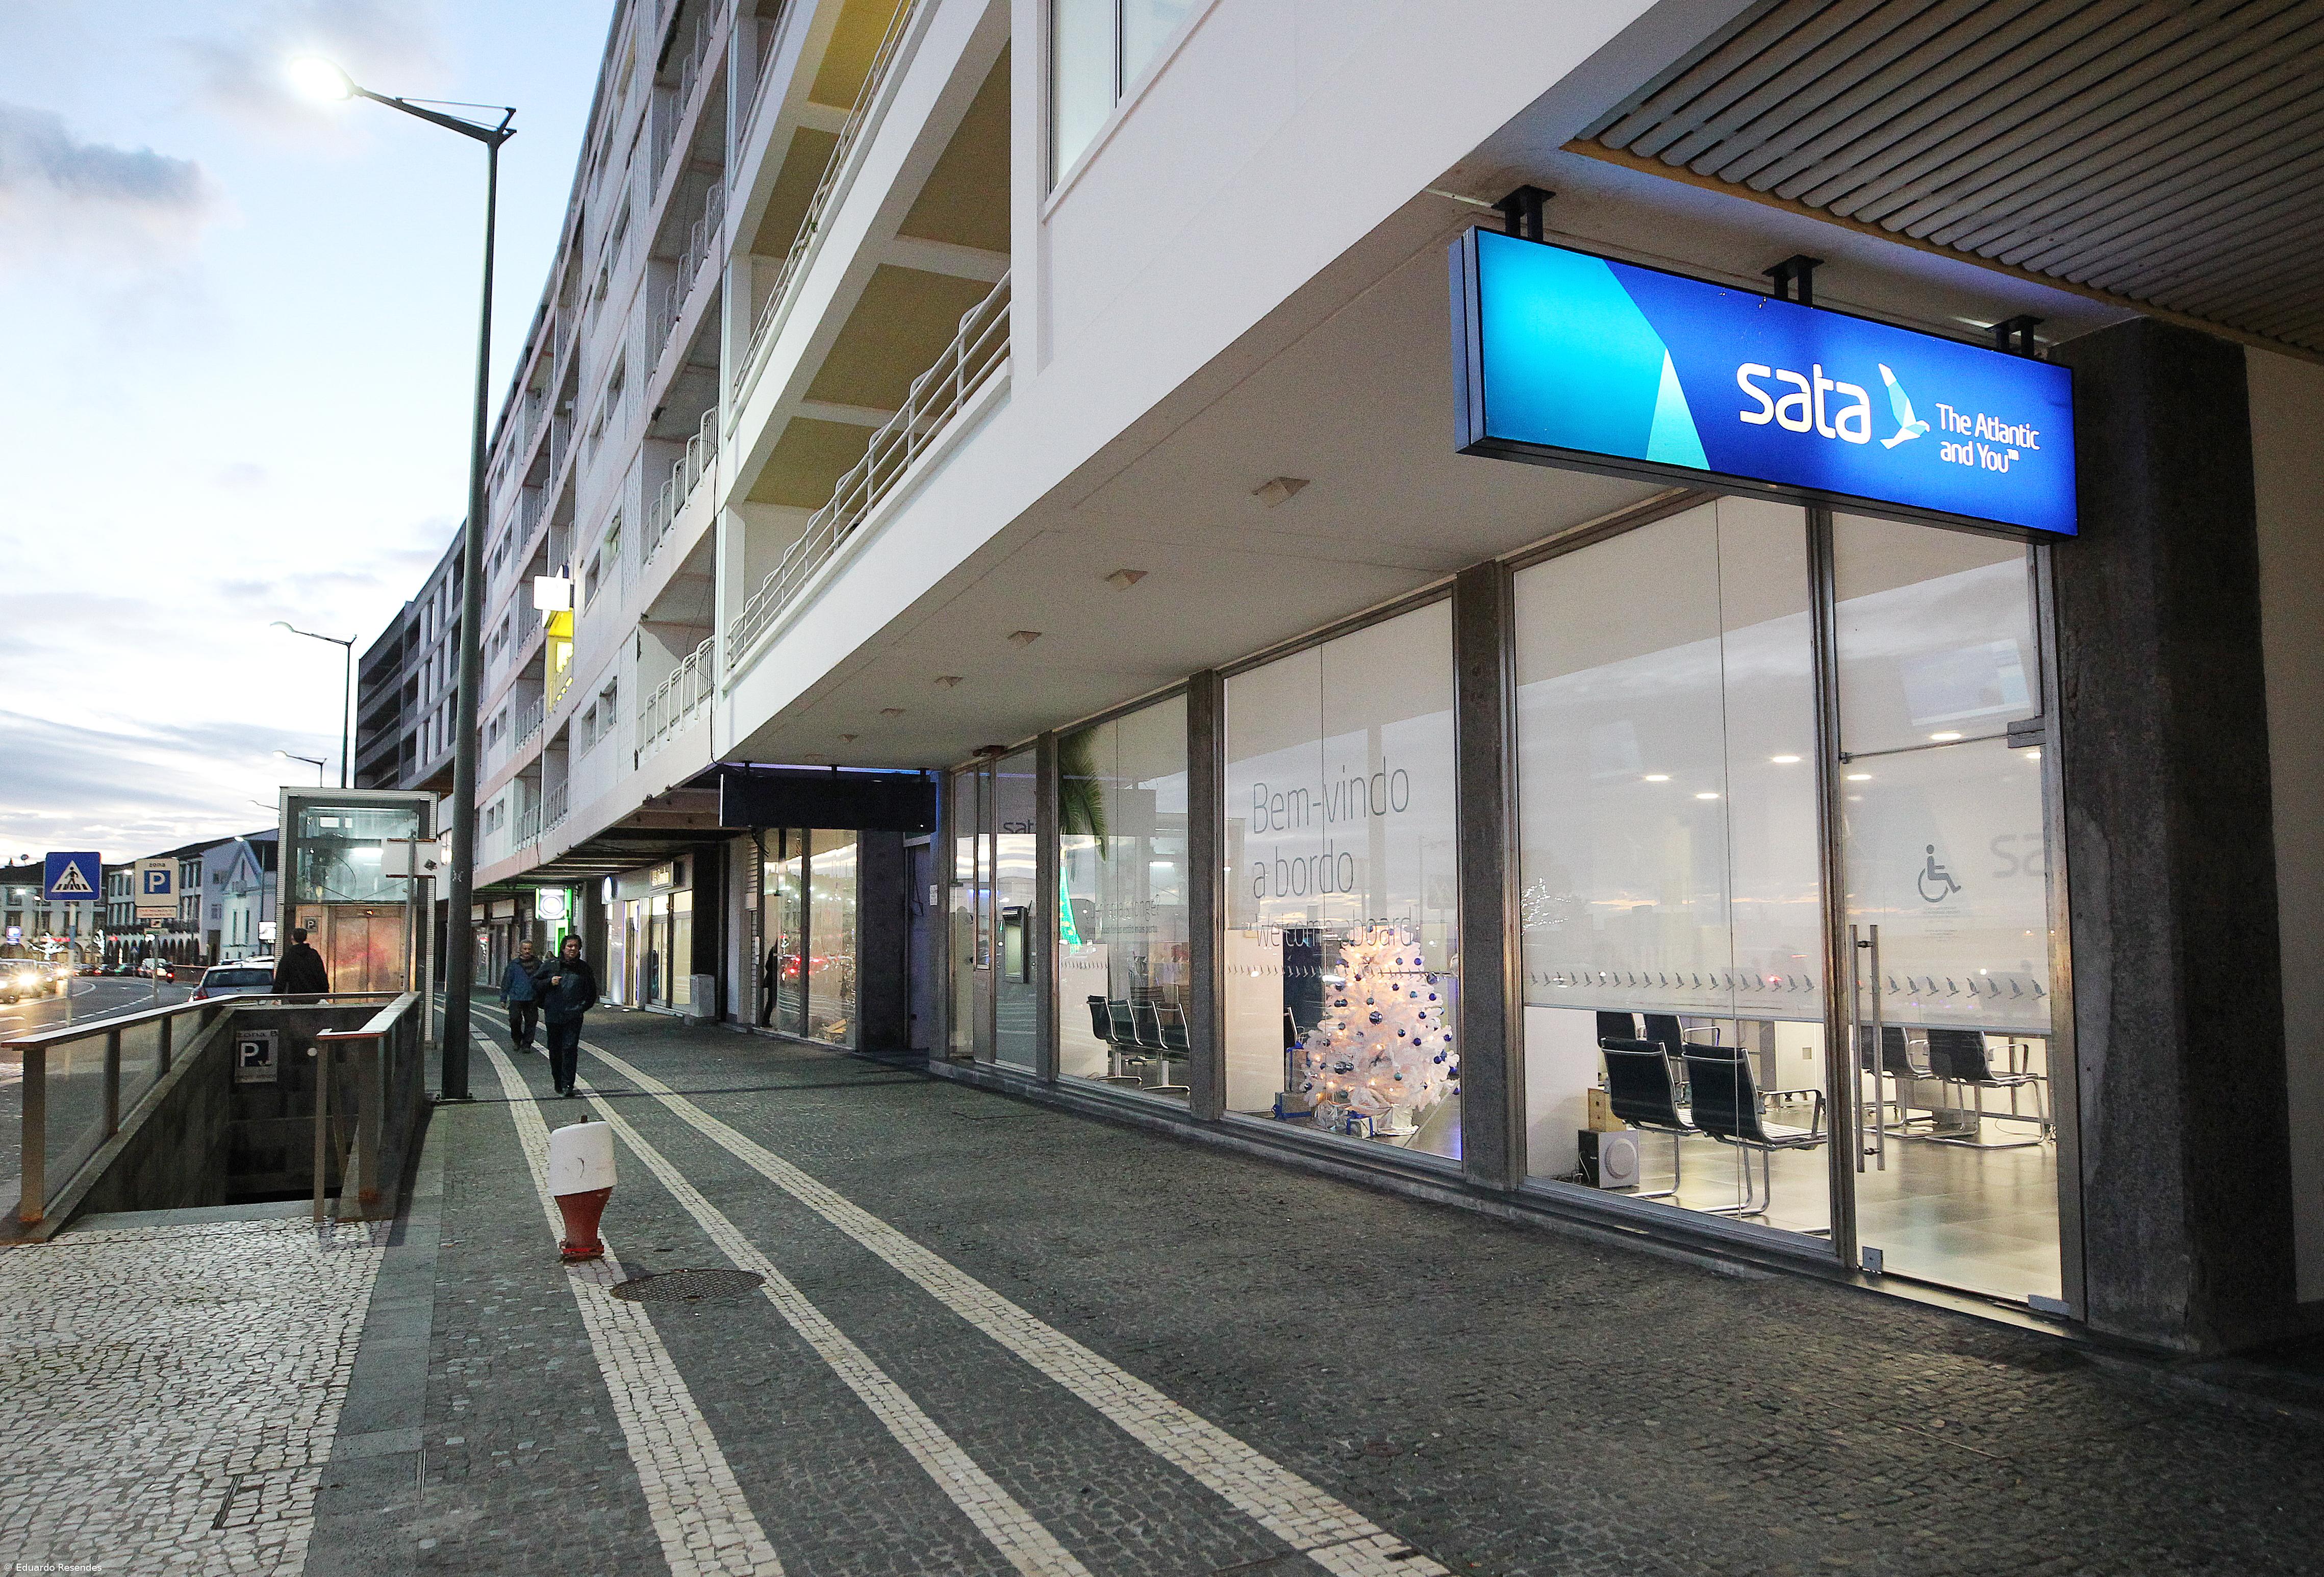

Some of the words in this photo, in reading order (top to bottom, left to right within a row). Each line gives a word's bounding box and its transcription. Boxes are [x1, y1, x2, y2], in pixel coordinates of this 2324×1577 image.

[1736, 362, 1872, 444] sata
[1935, 403, 1972, 436] The
[1975, 412, 2040, 450] Atlantic
[1940, 441, 1974, 466] and
[1253, 756, 1409, 834] Bem-vindo
[149, 872, 166, 892] P
[1253, 861, 1265, 899] a
[1276, 839, 1353, 898] bordo
[307, 920, 314, 929] P
[1341, 906, 1412, 946] aboard
[240, 1042, 259, 1067] P
